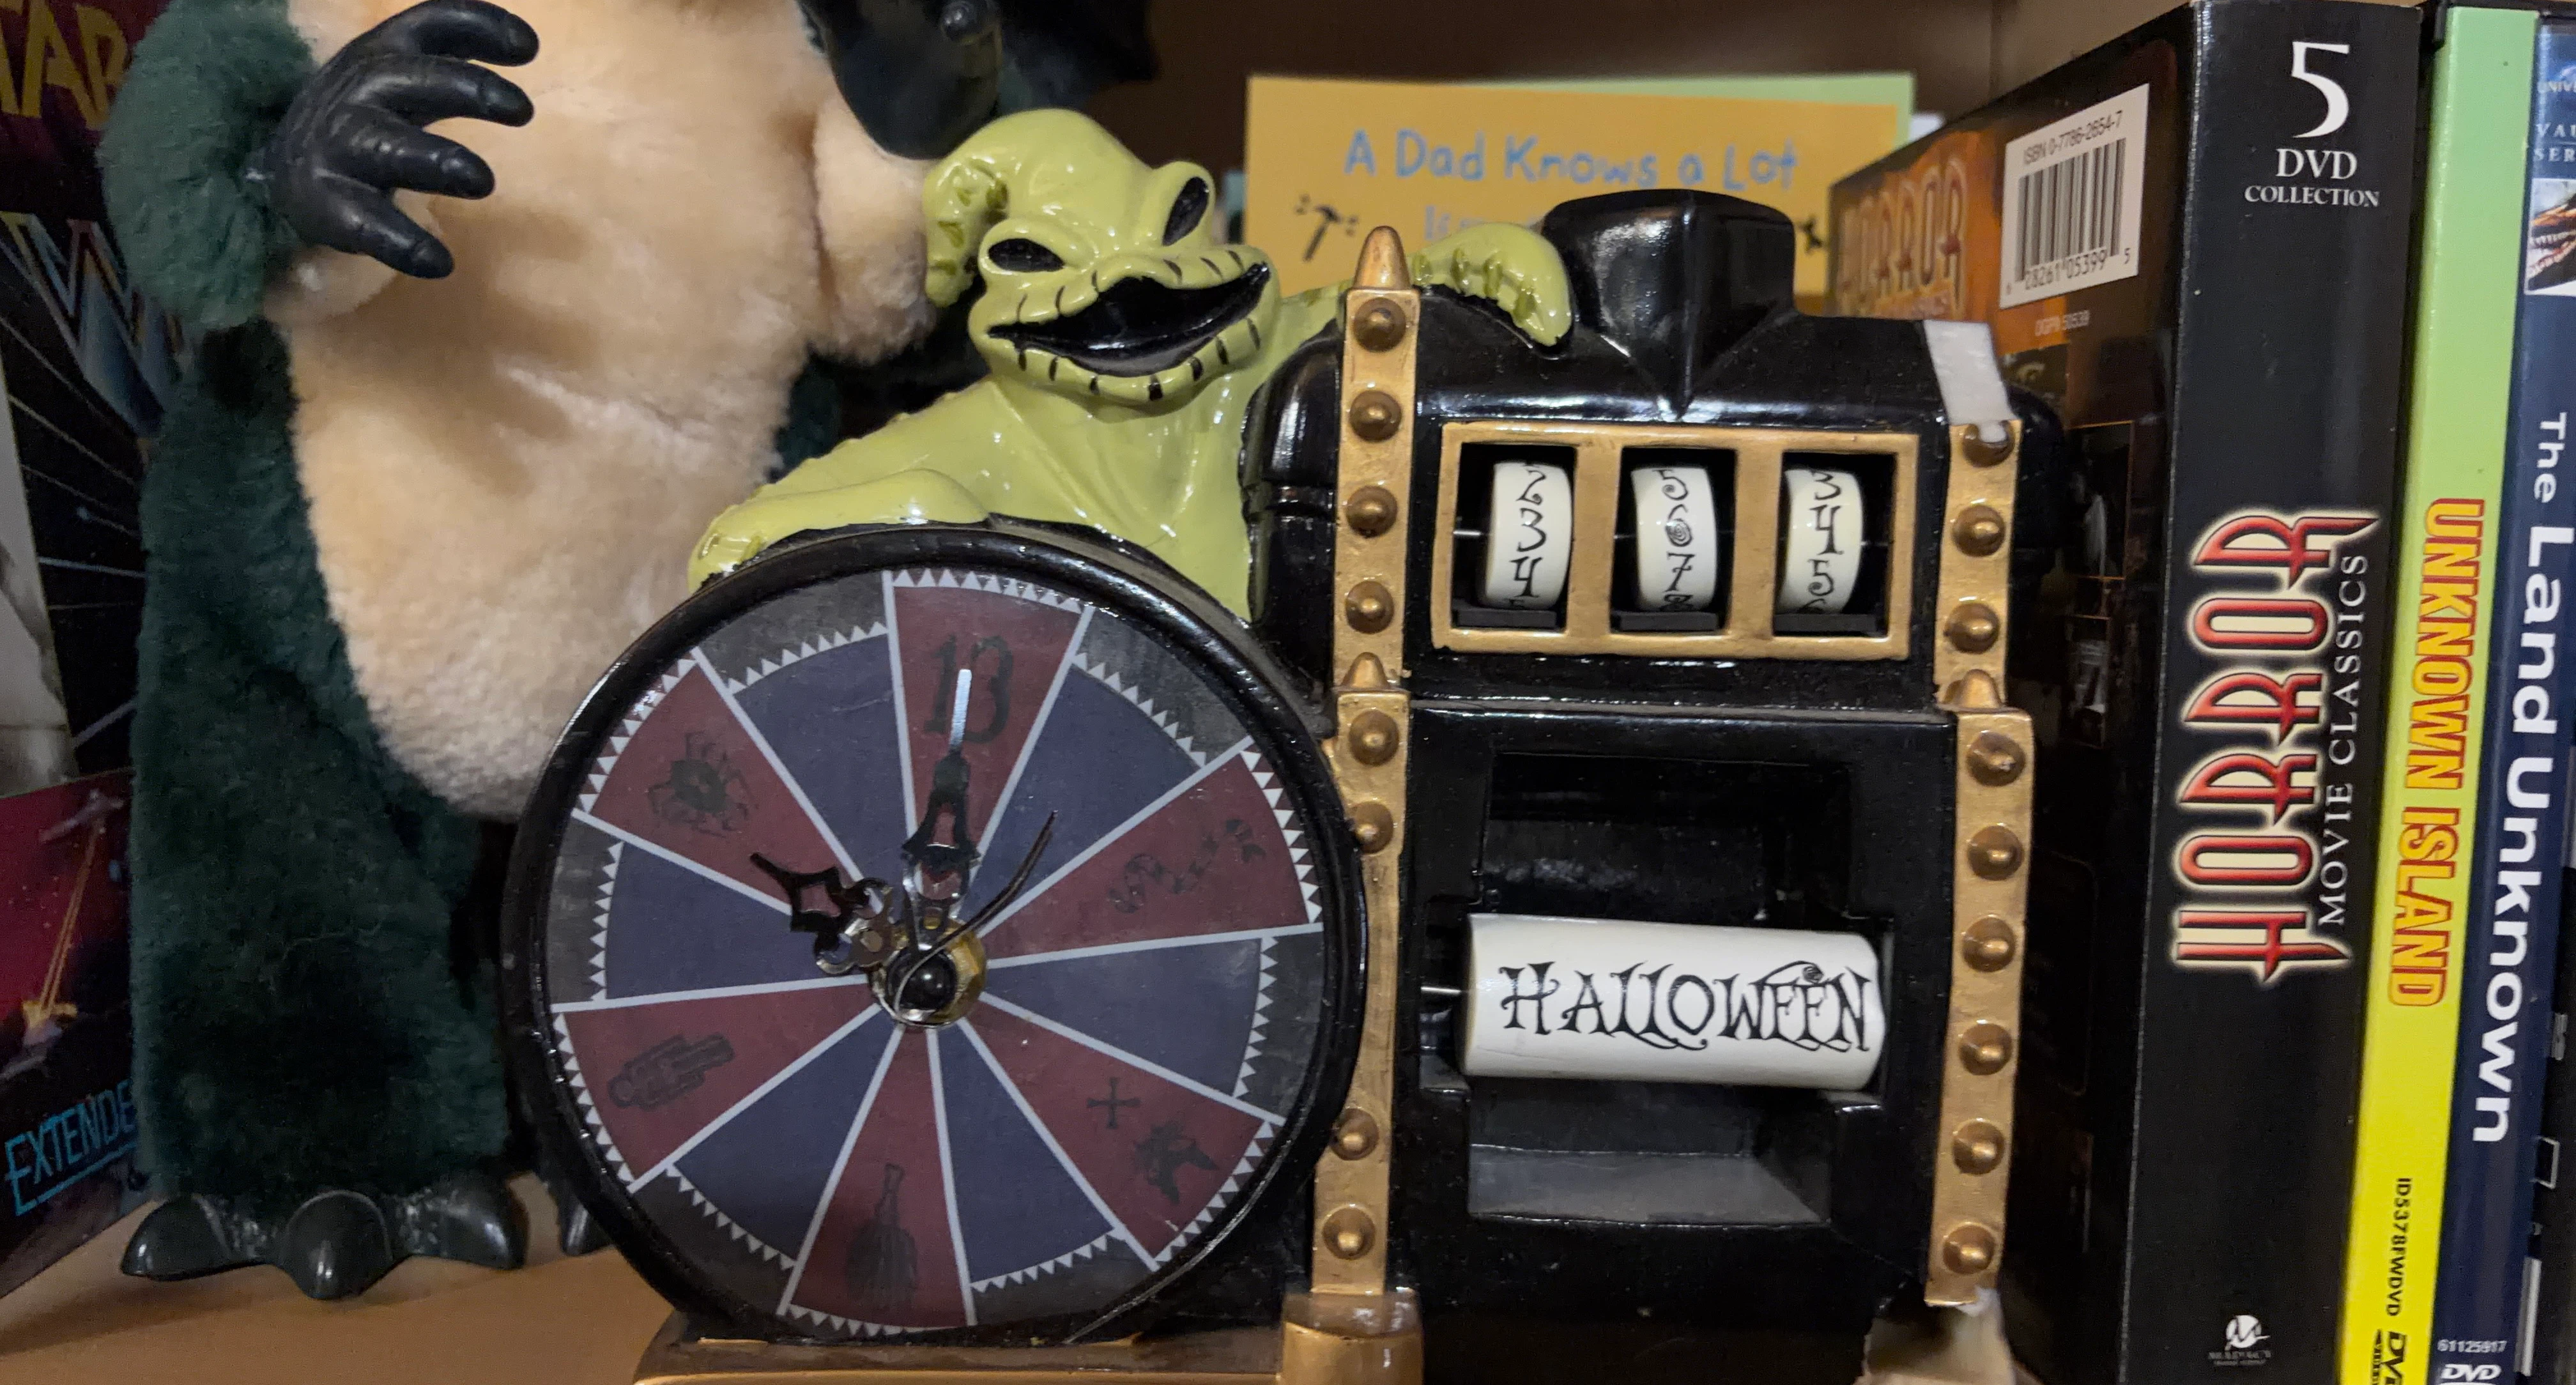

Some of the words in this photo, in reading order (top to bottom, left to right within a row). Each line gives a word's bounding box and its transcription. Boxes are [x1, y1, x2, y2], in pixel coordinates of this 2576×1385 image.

[2291, 41, 2349, 138] 5
[1344, 129, 1376, 176] A
[1395, 130, 1486, 181] Dad
[1504, 135, 1657, 188] Knows
[1678, 153, 1705, 185] a
[1723, 139, 1798, 190] Lot
[2023, 142, 2047, 165] ISBN
[2276, 148, 2358, 180] DVD
[2244, 184, 2380, 208] COLLECTION
[2124, 247, 2131, 264] 5
[2533, 411, 2567, 503] The
[1516, 470, 1546, 505] 2
[1652, 469, 1689, 501] 5
[1809, 470, 1842, 501] 3
[1517, 507, 1547, 552] 3
[1664, 503, 1693, 547] 6
[1809, 504, 1844, 555] 4
[1509, 556, 1544, 598] 4
[1664, 551, 1696, 592] 7
[1807, 558, 1834, 597] 5
[2405, 498, 2485, 790] UNKNOWN
[2512, 526, 2575, 735] Land
[2329, 555, 2368, 765] CLASSICS
[924, 634, 1013, 743] 13
[2174, 510, 2381, 986] HORROR
[2319, 782, 2352, 926] MOVIE
[2388, 806, 2461, 1007] ISLAND
[2472, 756, 2554, 1142] Unknown
[1498, 960, 1871, 1052] HALLOWEEN
[2386, 1177, 2412, 1317] ID5378FWDVD
[2441, 1363, 2502, 1382] DVD
